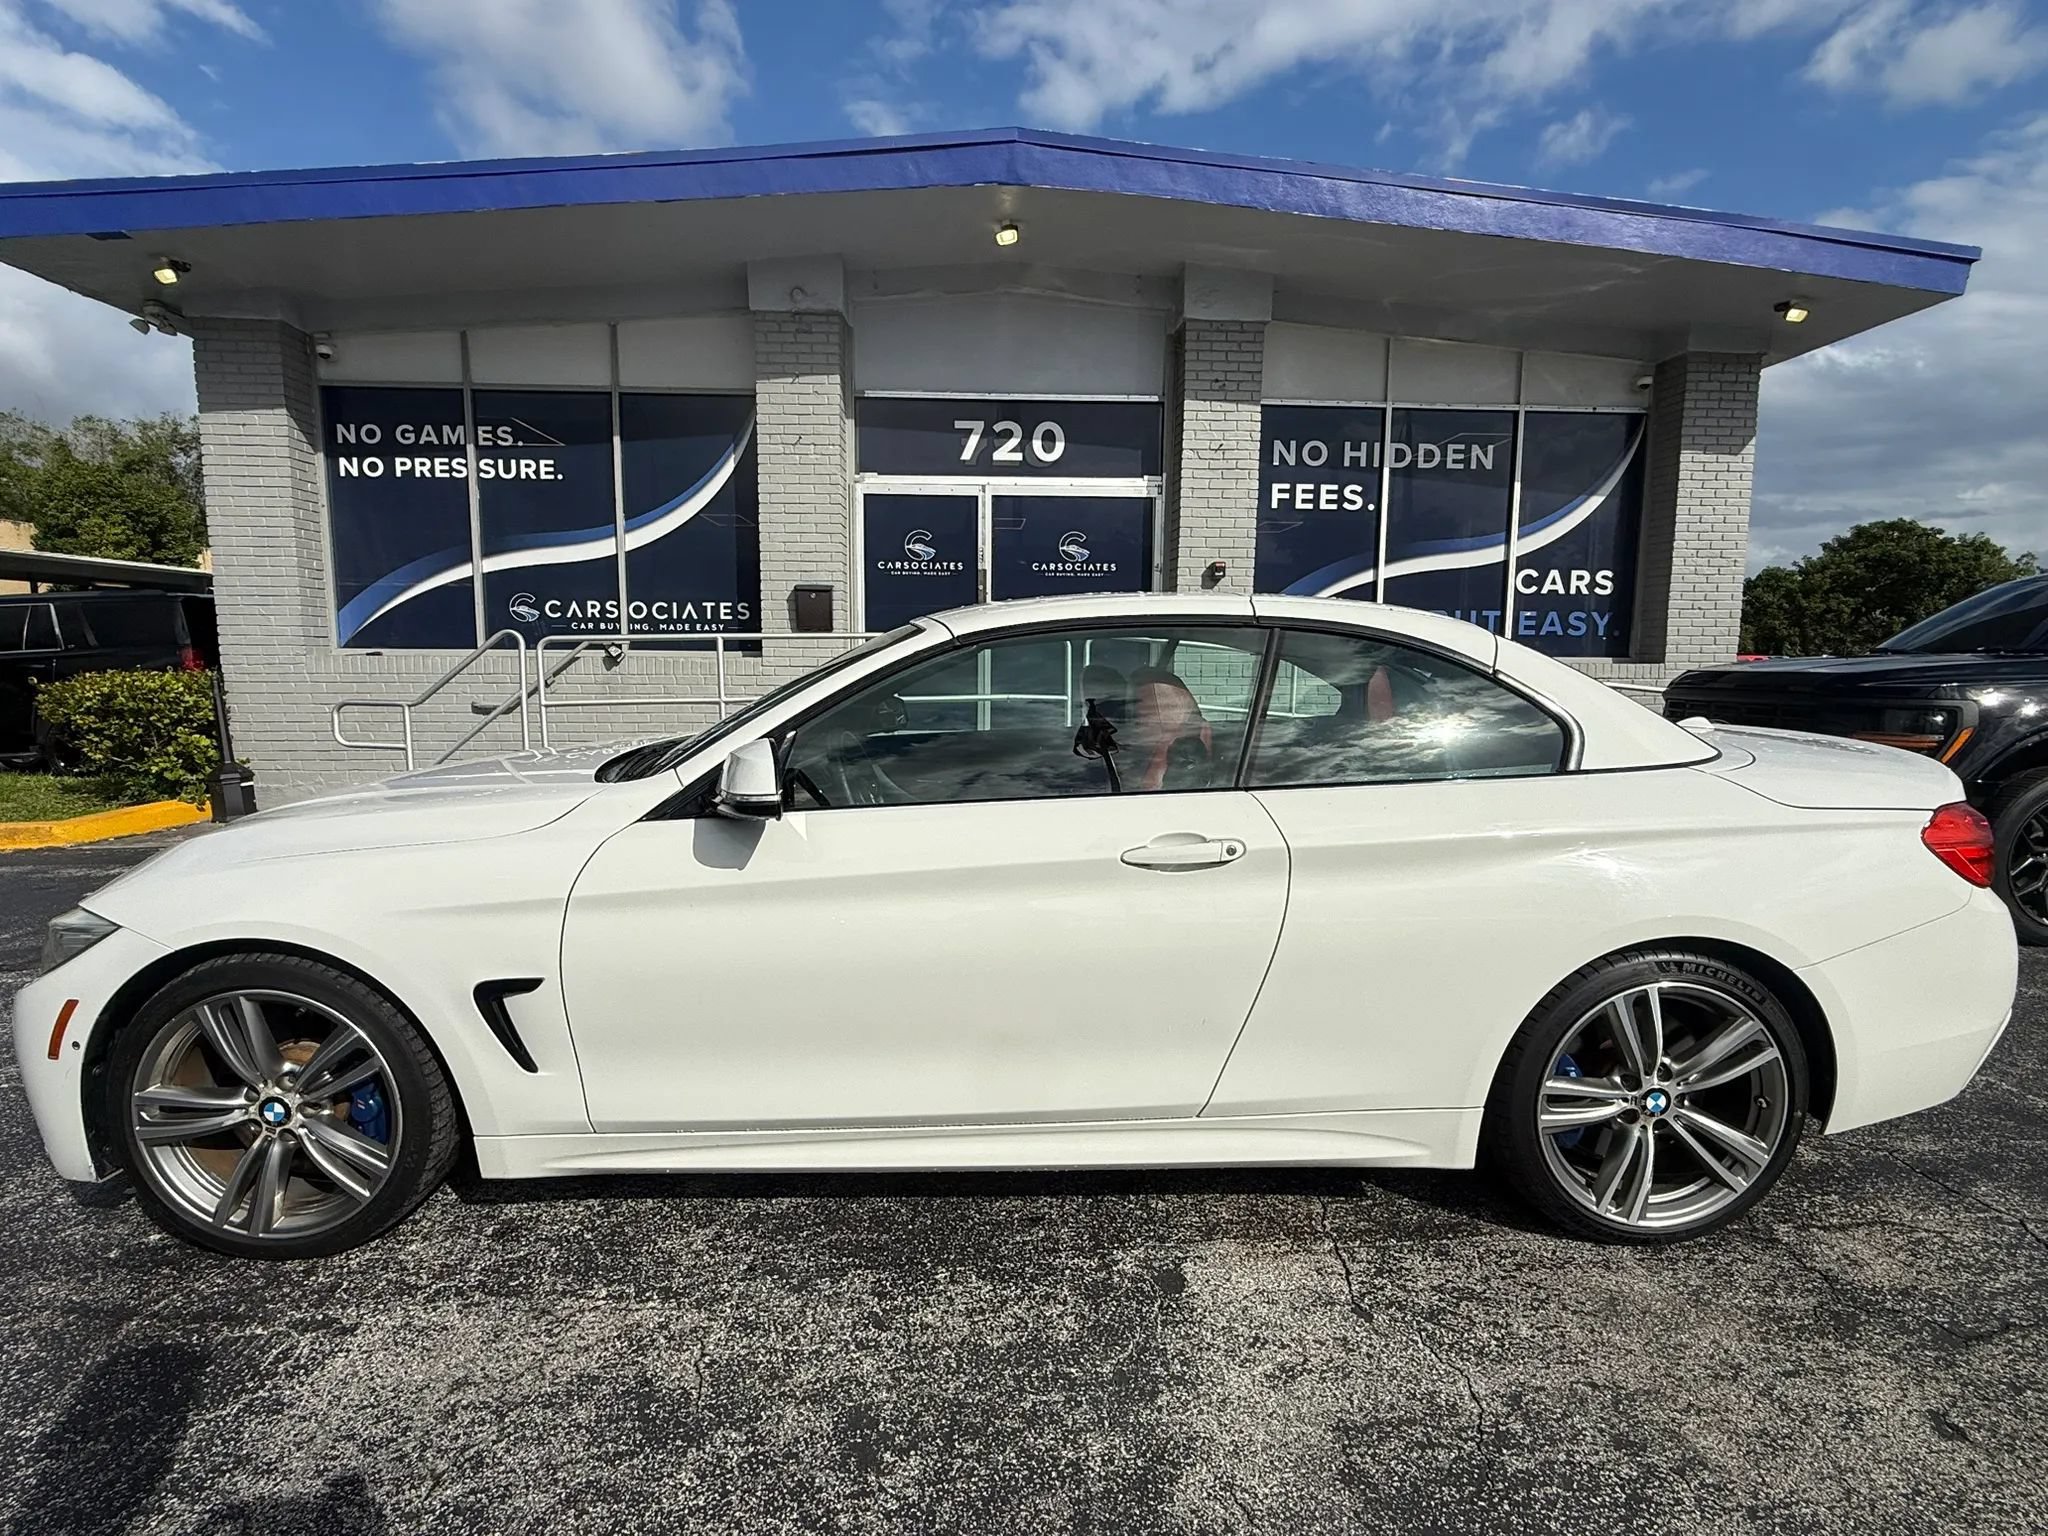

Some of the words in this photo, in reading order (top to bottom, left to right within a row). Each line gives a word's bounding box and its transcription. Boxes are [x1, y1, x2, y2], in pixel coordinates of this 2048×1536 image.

[336, 423, 382, 445] NO
[395, 424, 524, 447] GAMES.
[954, 420, 1066, 463] 720
[1272, 440, 1329, 467] NO
[1343, 441, 1495, 470] HIDDEN
[338, 456, 385, 478] NO
[394, 457, 564, 480] PRESSURE.
[1271, 483, 1375, 511] FEES.
[877, 561, 964, 571] CARSOCIATES
[1032, 562, 1117, 572] CARSOCIATES
[1515, 568, 1615, 596] CARS
[544, 600, 751, 620] CARSOCIATES
[571, 622, 595, 630] CAR
[659, 623, 691, 631] MADE
[696, 623, 725, 631] EASY
[1518, 610, 1620, 637] EASY.
[1682, 962, 1764, 1002] MICHELIN
